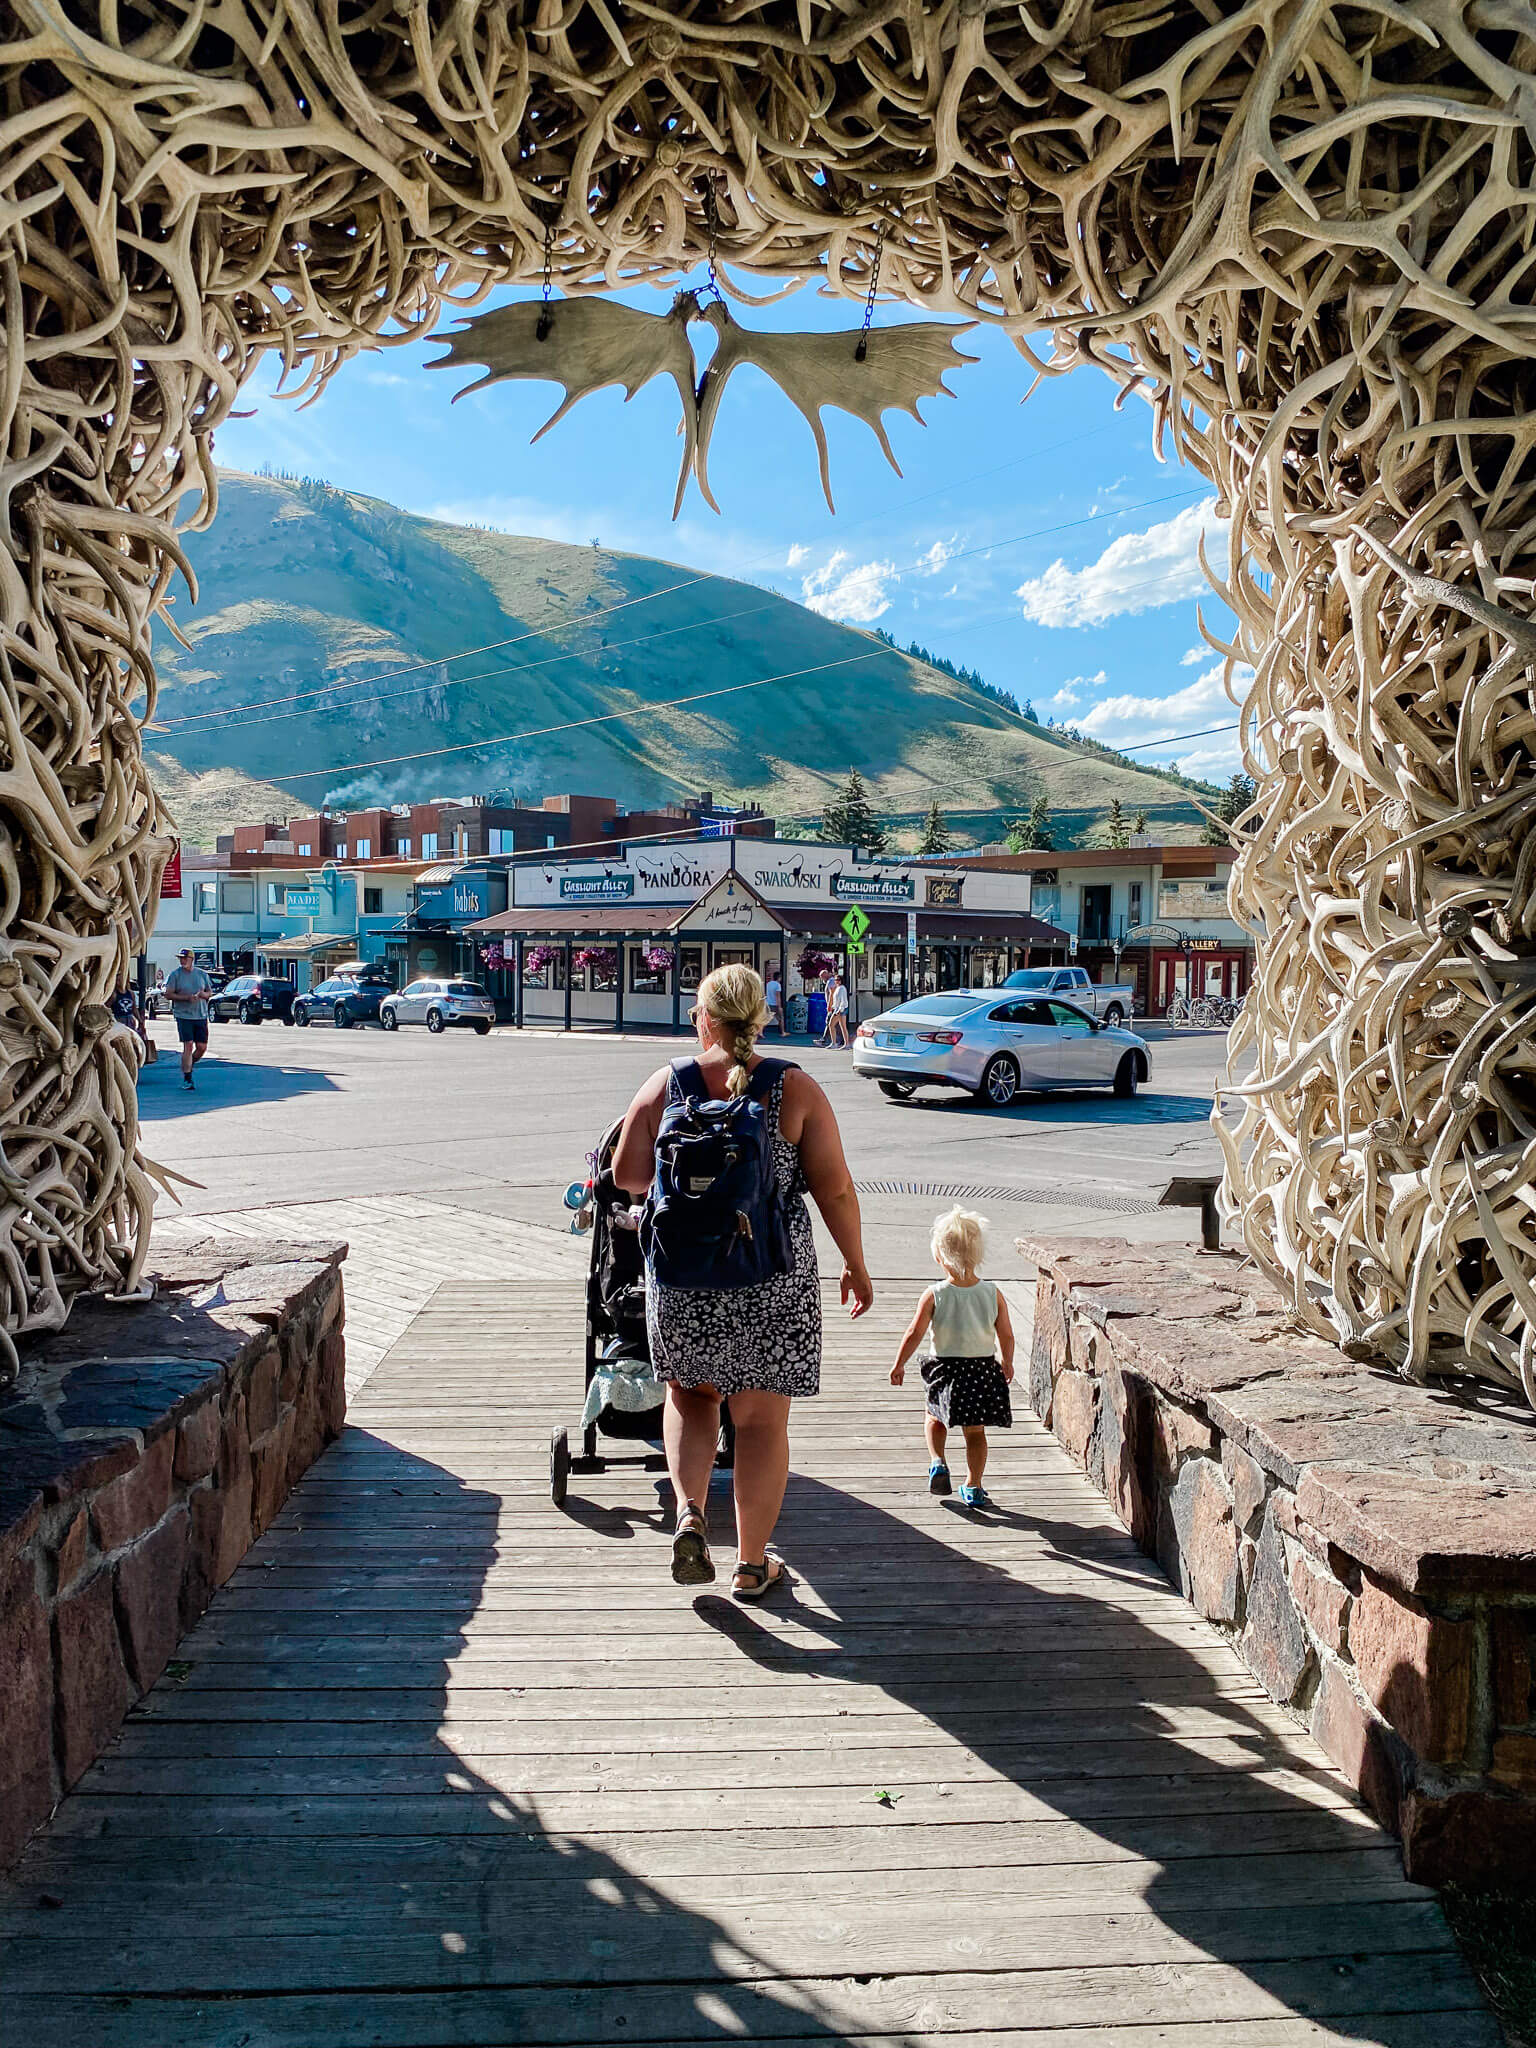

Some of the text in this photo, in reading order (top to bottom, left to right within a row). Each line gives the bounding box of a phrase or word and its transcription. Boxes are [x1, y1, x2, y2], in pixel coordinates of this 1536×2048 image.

[644, 866, 712, 888] PANDORA
[754, 870, 821, 889] SWAROVSKI
[602, 879, 629, 891] ALLEY
[881, 881, 910, 895] ALLEY
[288, 895, 320, 905] MADE
[454, 884, 479, 912] habits
[1181, 940, 1219, 948] GALLERY
